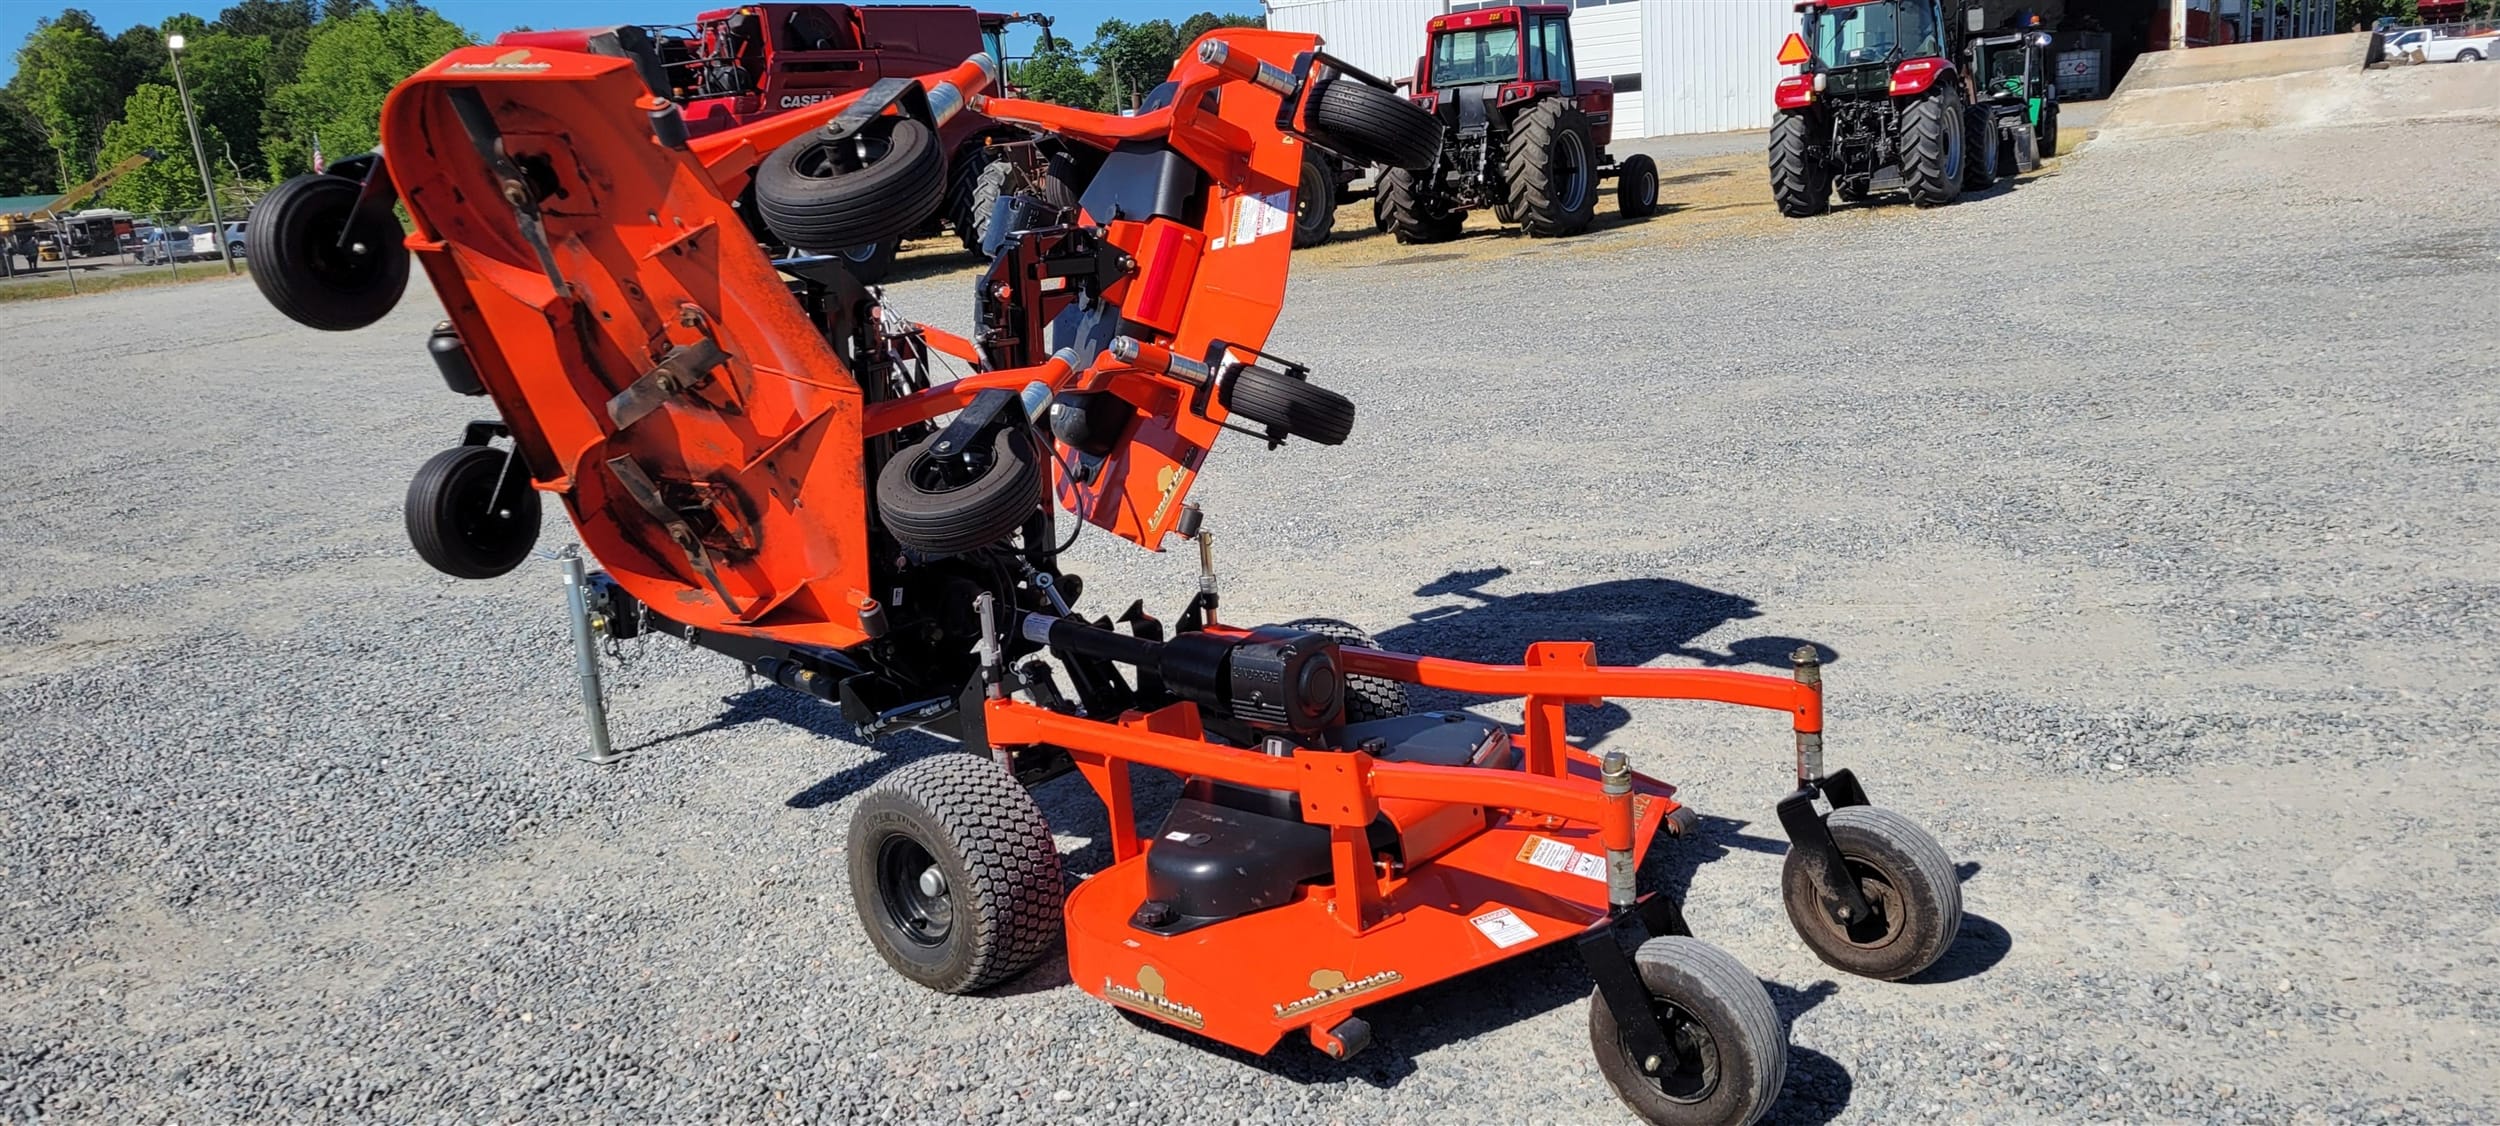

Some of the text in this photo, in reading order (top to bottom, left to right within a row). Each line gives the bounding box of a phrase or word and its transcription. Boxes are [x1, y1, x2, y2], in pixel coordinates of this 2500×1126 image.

[780, 95, 821, 108] CASE
[1104, 975, 1203, 1022] Land Pride
[1273, 970, 1399, 1013] Land Pride
